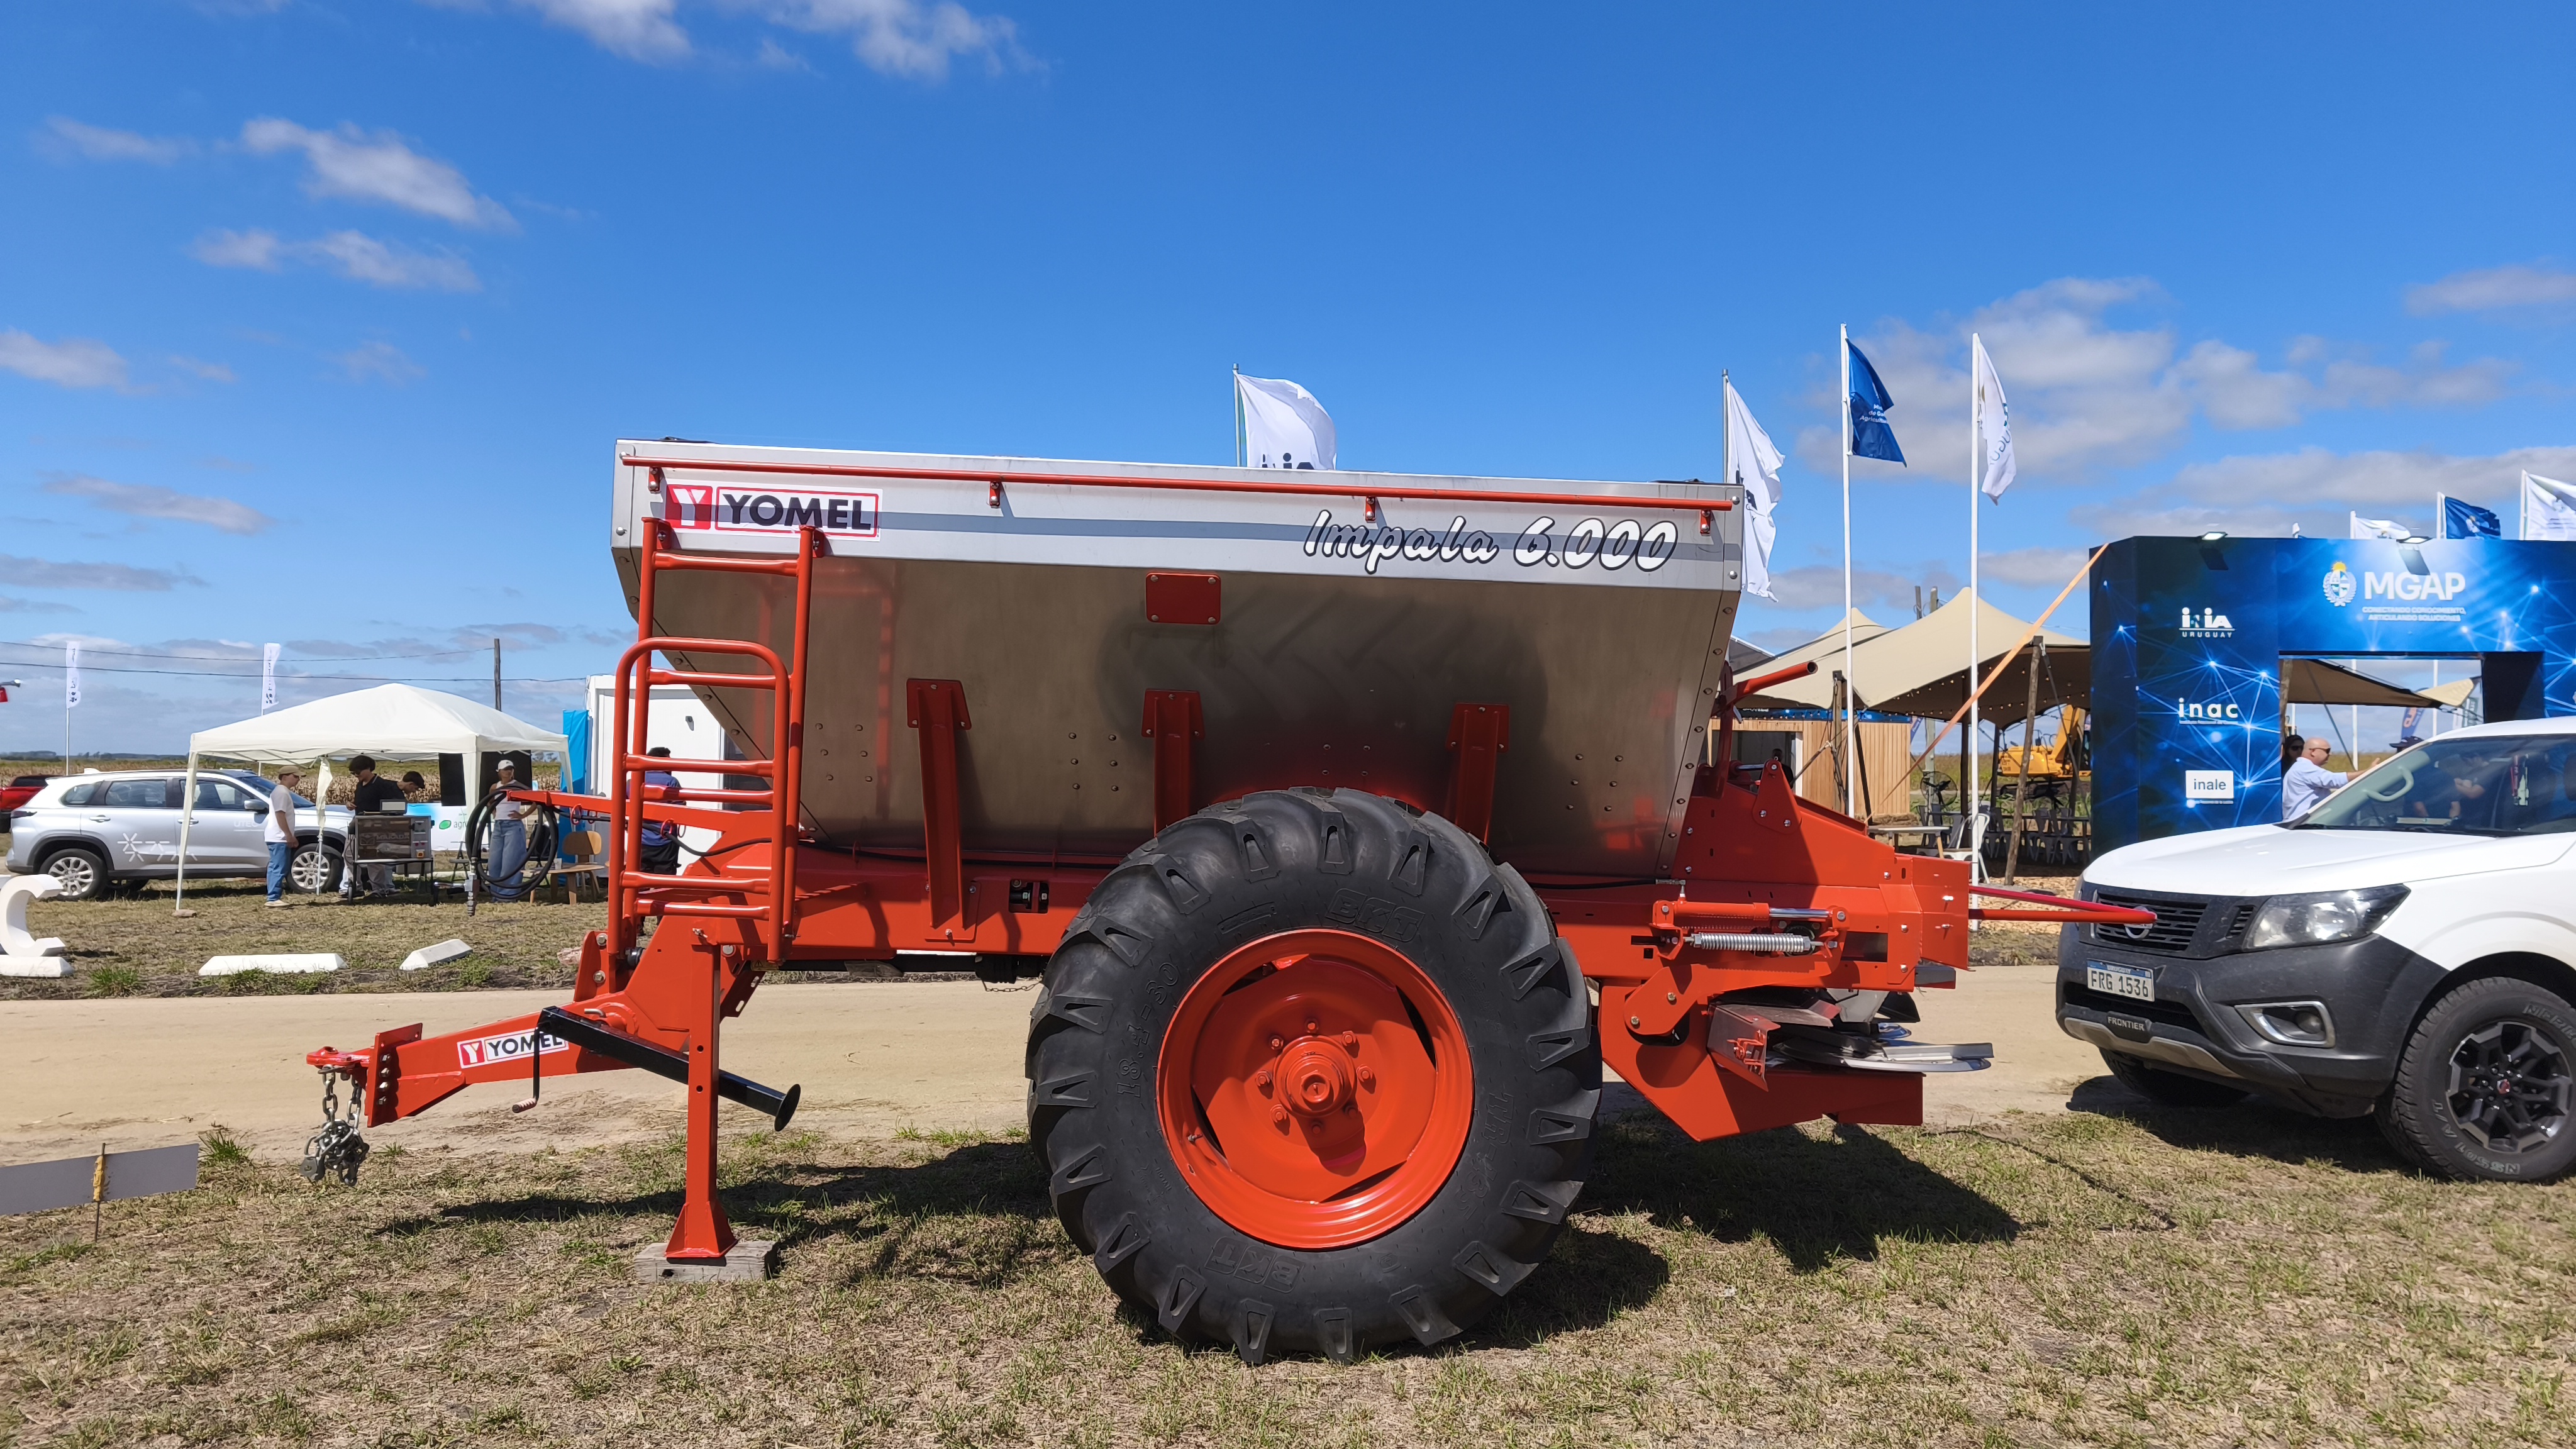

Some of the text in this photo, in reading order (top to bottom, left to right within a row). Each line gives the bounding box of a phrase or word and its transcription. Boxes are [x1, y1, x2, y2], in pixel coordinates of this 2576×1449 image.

[723, 493, 872, 531] YOMEL
[1303, 509, 1677, 574] Impala 6.000
[2364, 571, 2466, 601] MGAP
[2179, 697, 2238, 718] inac
[2194, 779, 2226, 790] inale
[1326, 889, 1424, 941] BKT
[2091, 970, 2148, 997] FRG 1536
[1117, 963, 1179, 1097] 18.4-30
[2107, 1016, 2145, 1031] FRONTIER
[488, 1033, 562, 1057] YOMEL
[1204, 1236, 1306, 1293] BKT
